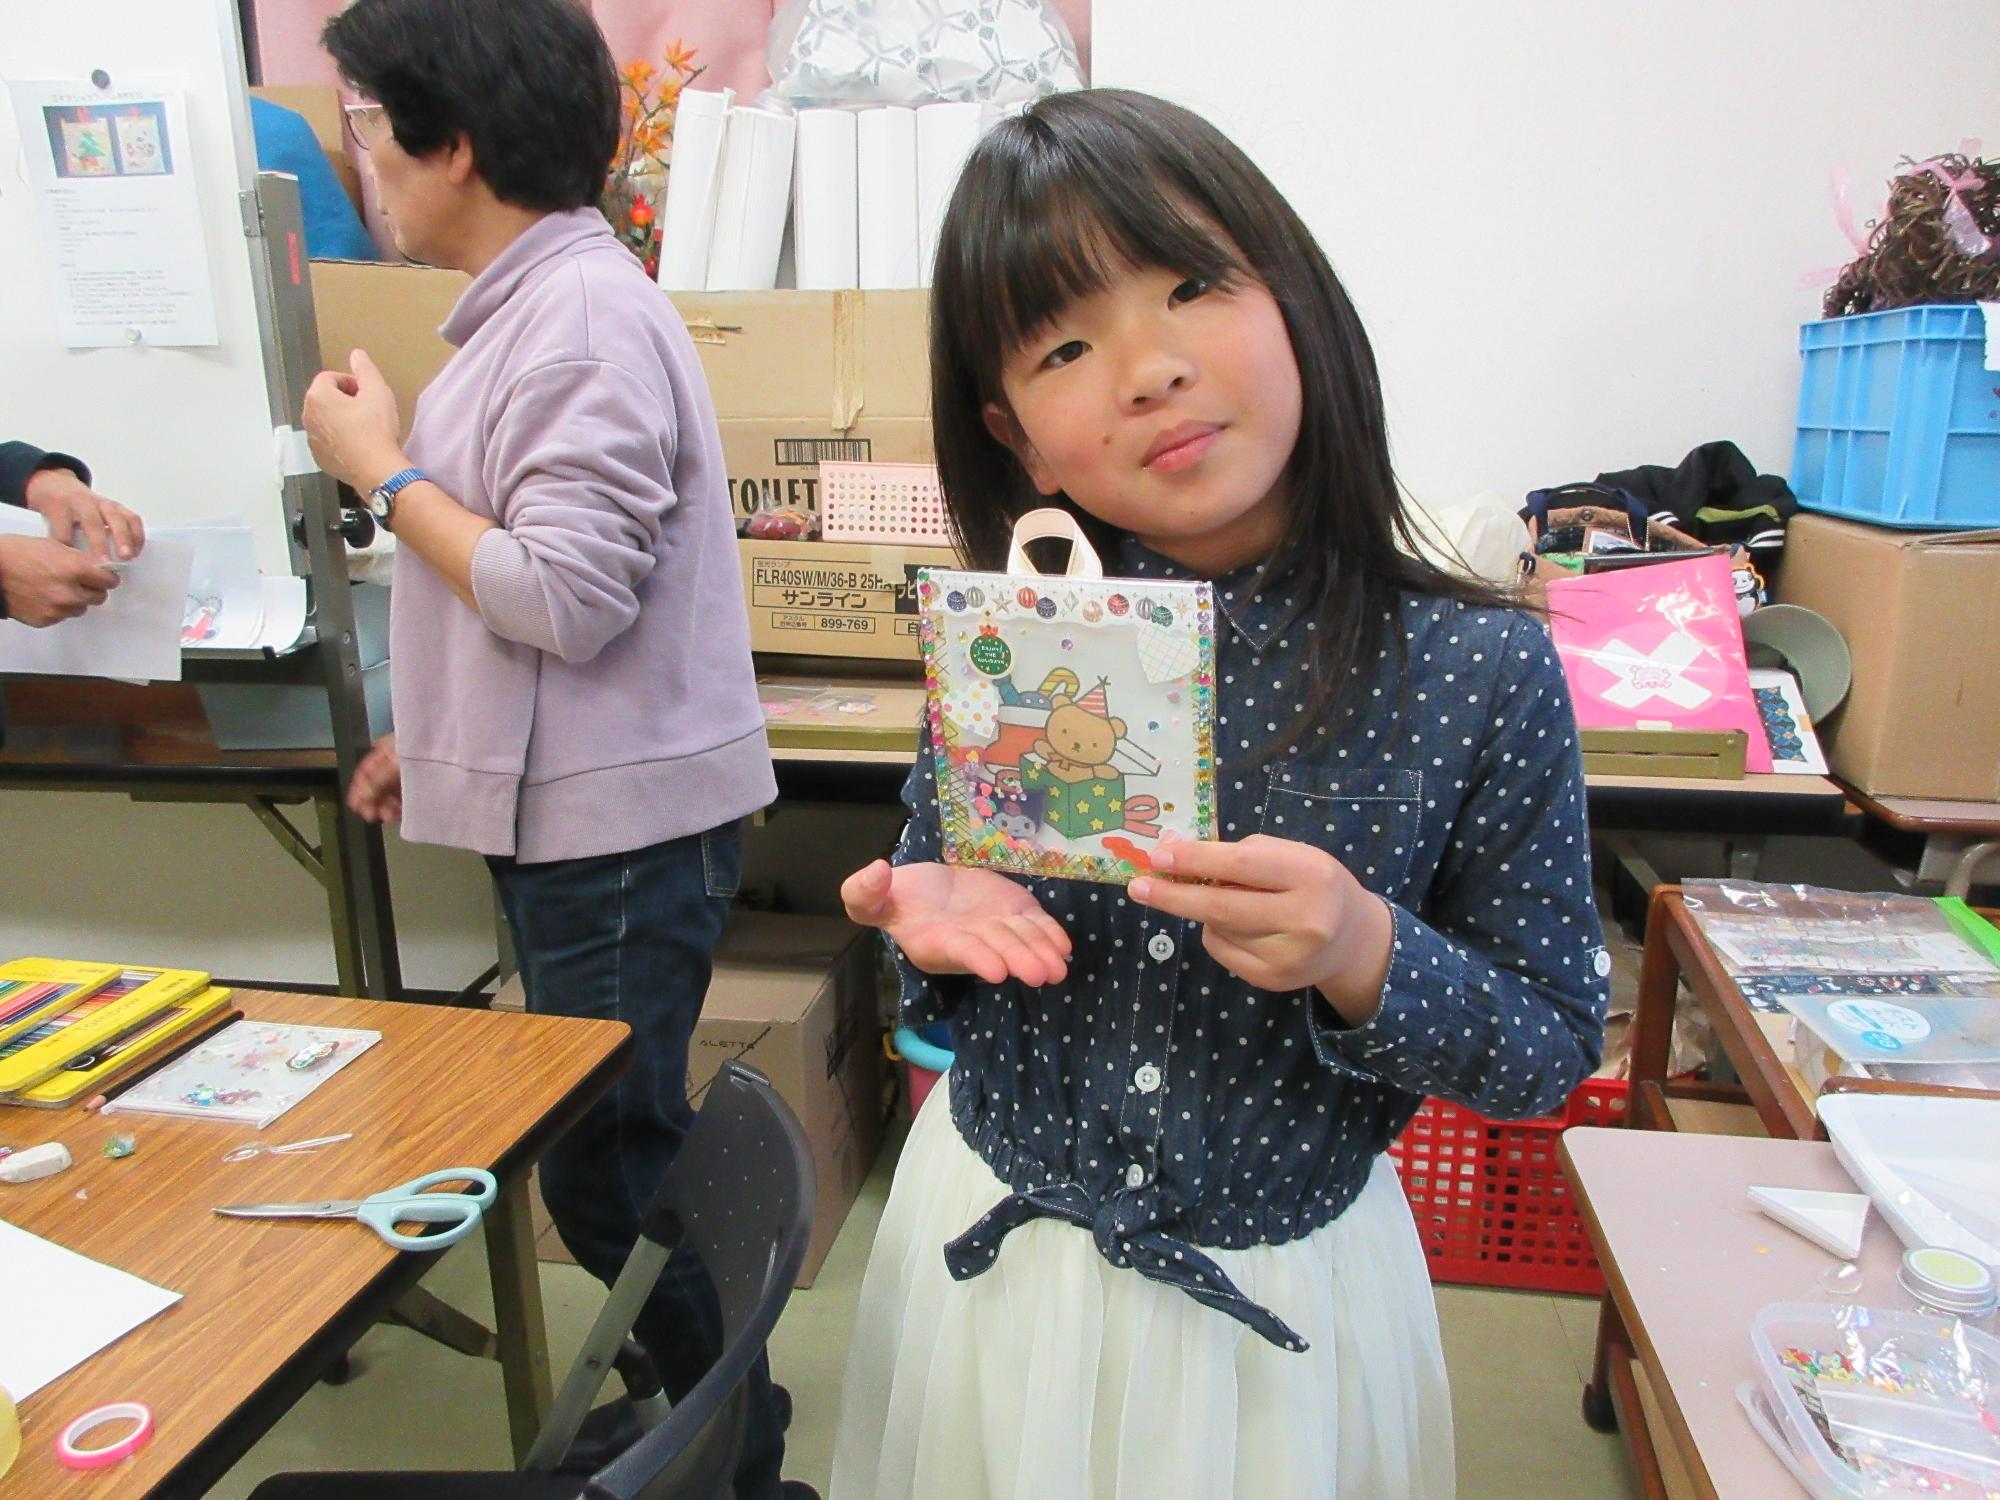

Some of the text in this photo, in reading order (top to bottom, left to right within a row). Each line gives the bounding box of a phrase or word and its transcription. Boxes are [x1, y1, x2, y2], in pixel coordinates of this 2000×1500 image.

[781, 589, 867, 609] サンライン
[820, 617, 869, 631] 899-769
